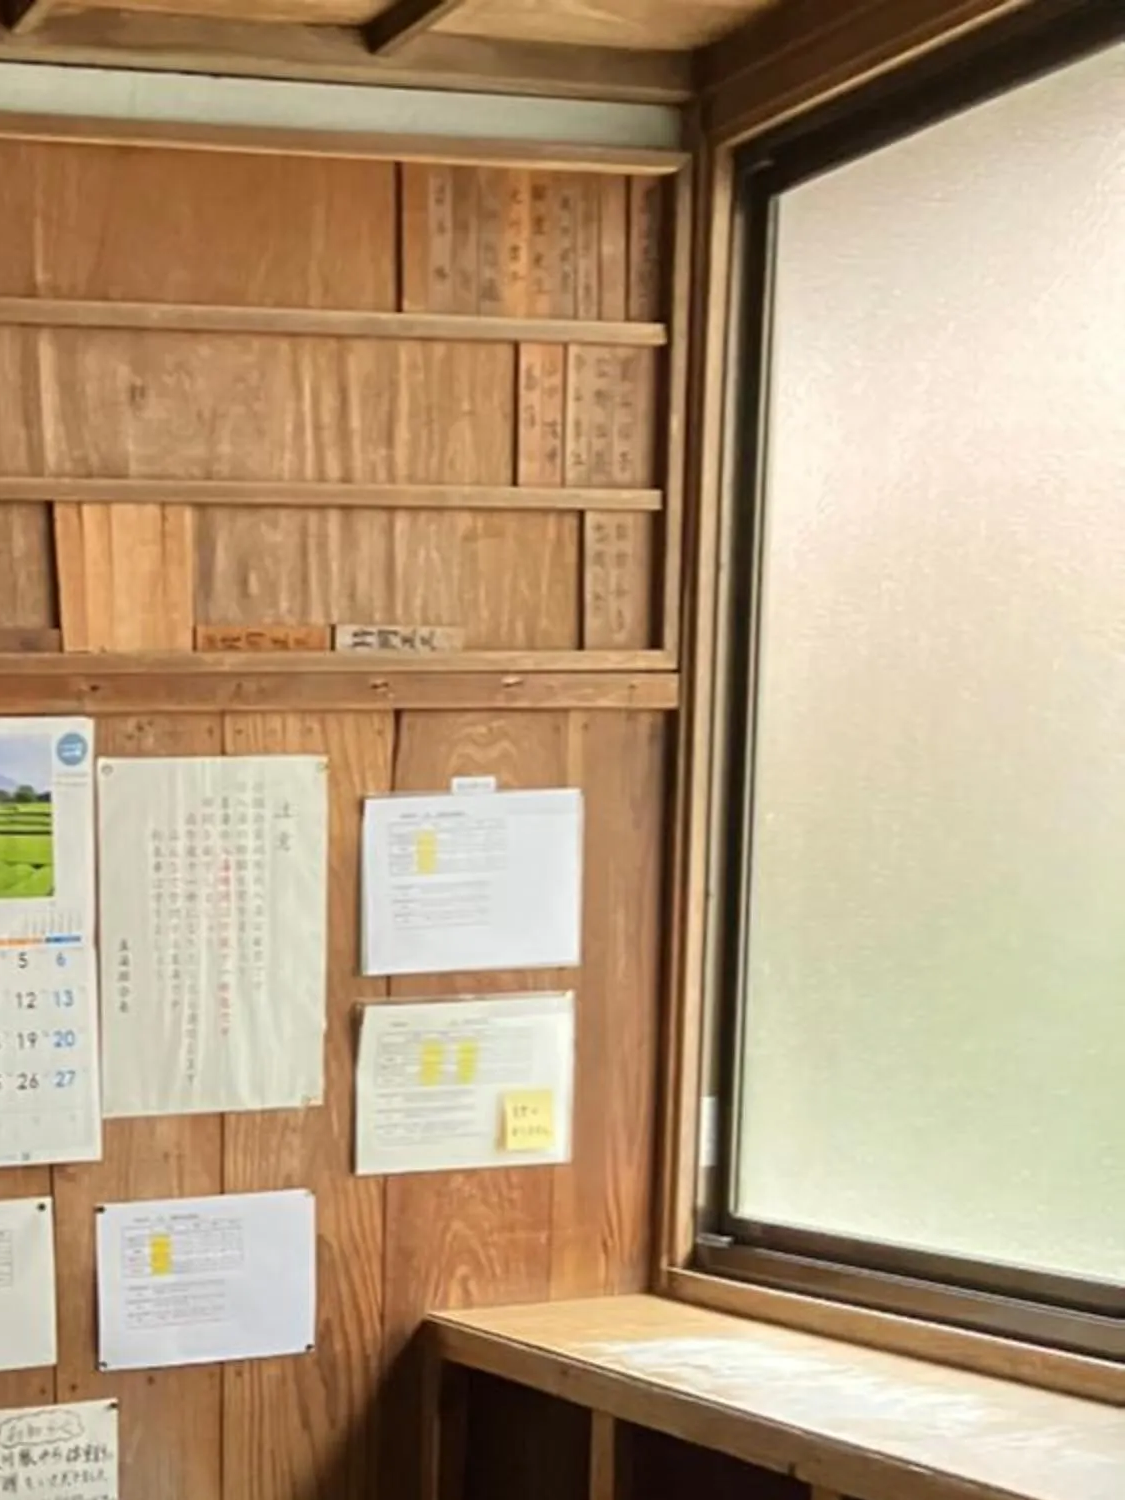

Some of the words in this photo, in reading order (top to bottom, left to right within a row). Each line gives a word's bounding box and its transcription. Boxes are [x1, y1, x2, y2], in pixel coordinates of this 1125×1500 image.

[19, 952, 29, 970] 5
[55, 951, 67, 968] 6
[17, 992, 37, 1010] 12
[56, 990, 75, 1009] 13
[18, 1032, 38, 1049] 19
[55, 1031, 76, 1049] 20
[18, 1073, 40, 1092] 26
[56, 1070, 77, 1089] 27
